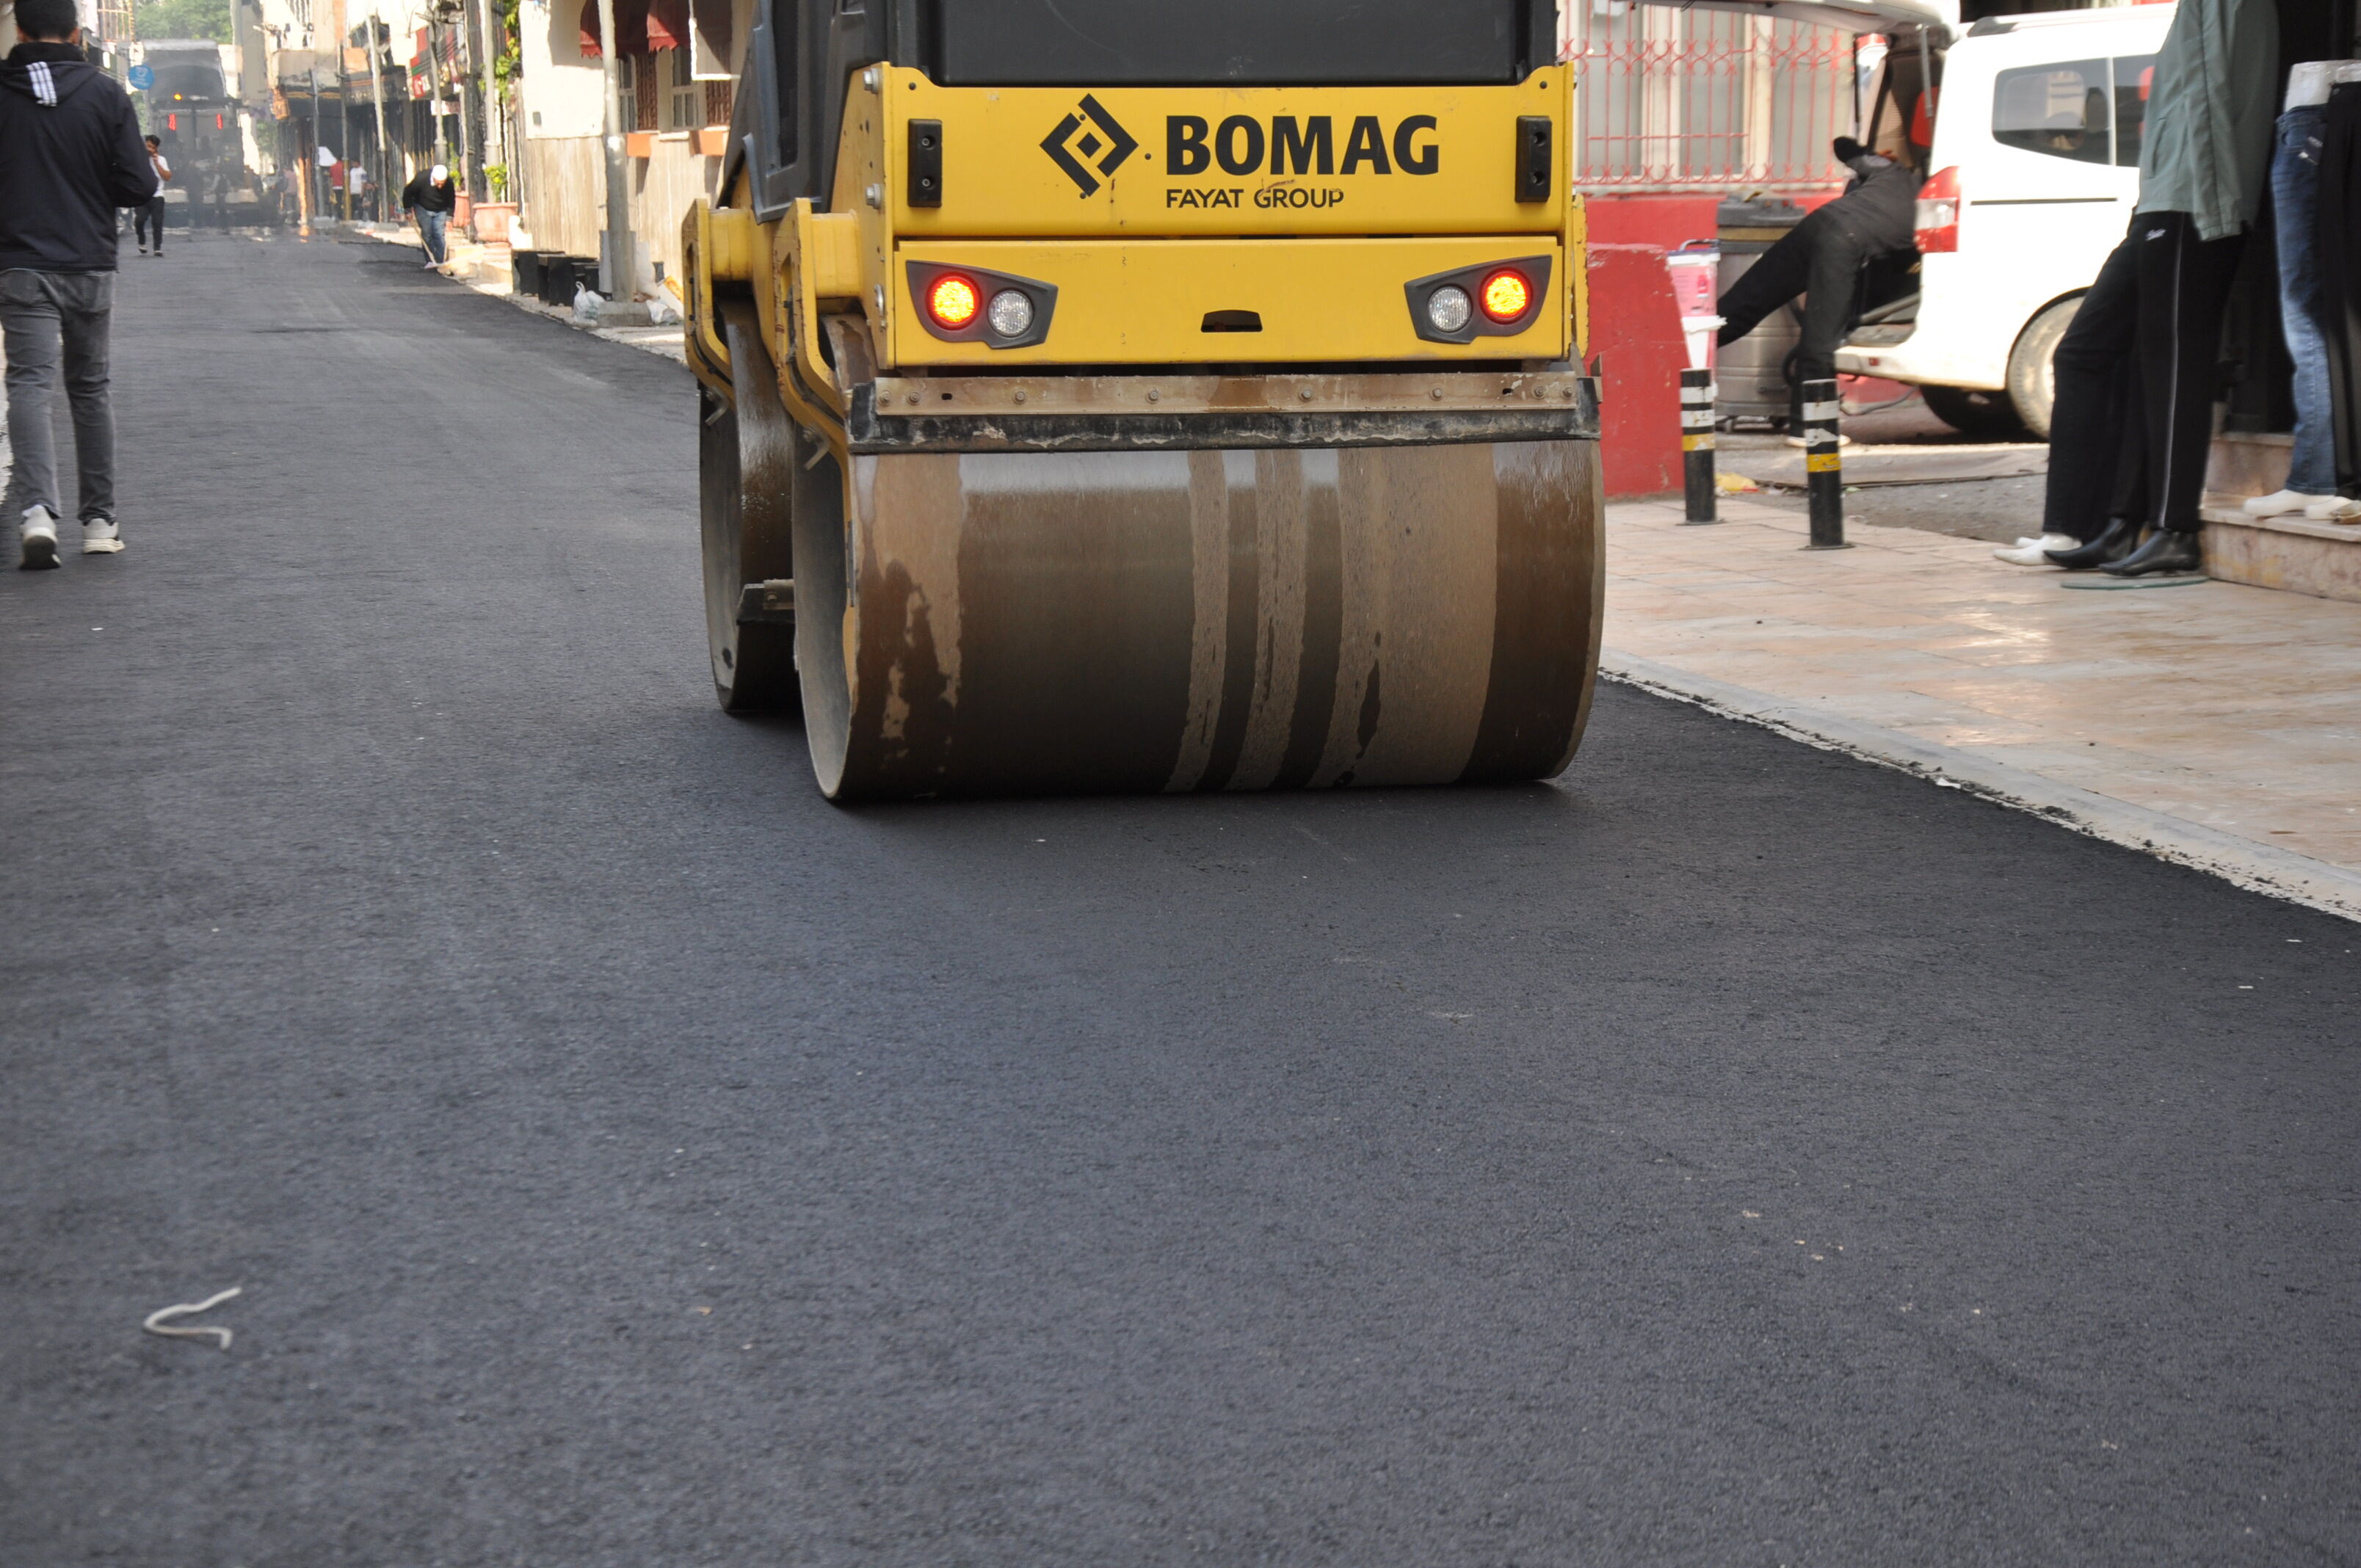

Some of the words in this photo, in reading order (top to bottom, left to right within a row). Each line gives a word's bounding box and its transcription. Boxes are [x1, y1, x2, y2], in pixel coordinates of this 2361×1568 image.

[1167, 115, 1439, 176] BOMAG
[1167, 189, 1244, 208] FAYAT
[1253, 188, 1344, 208] GROUP
